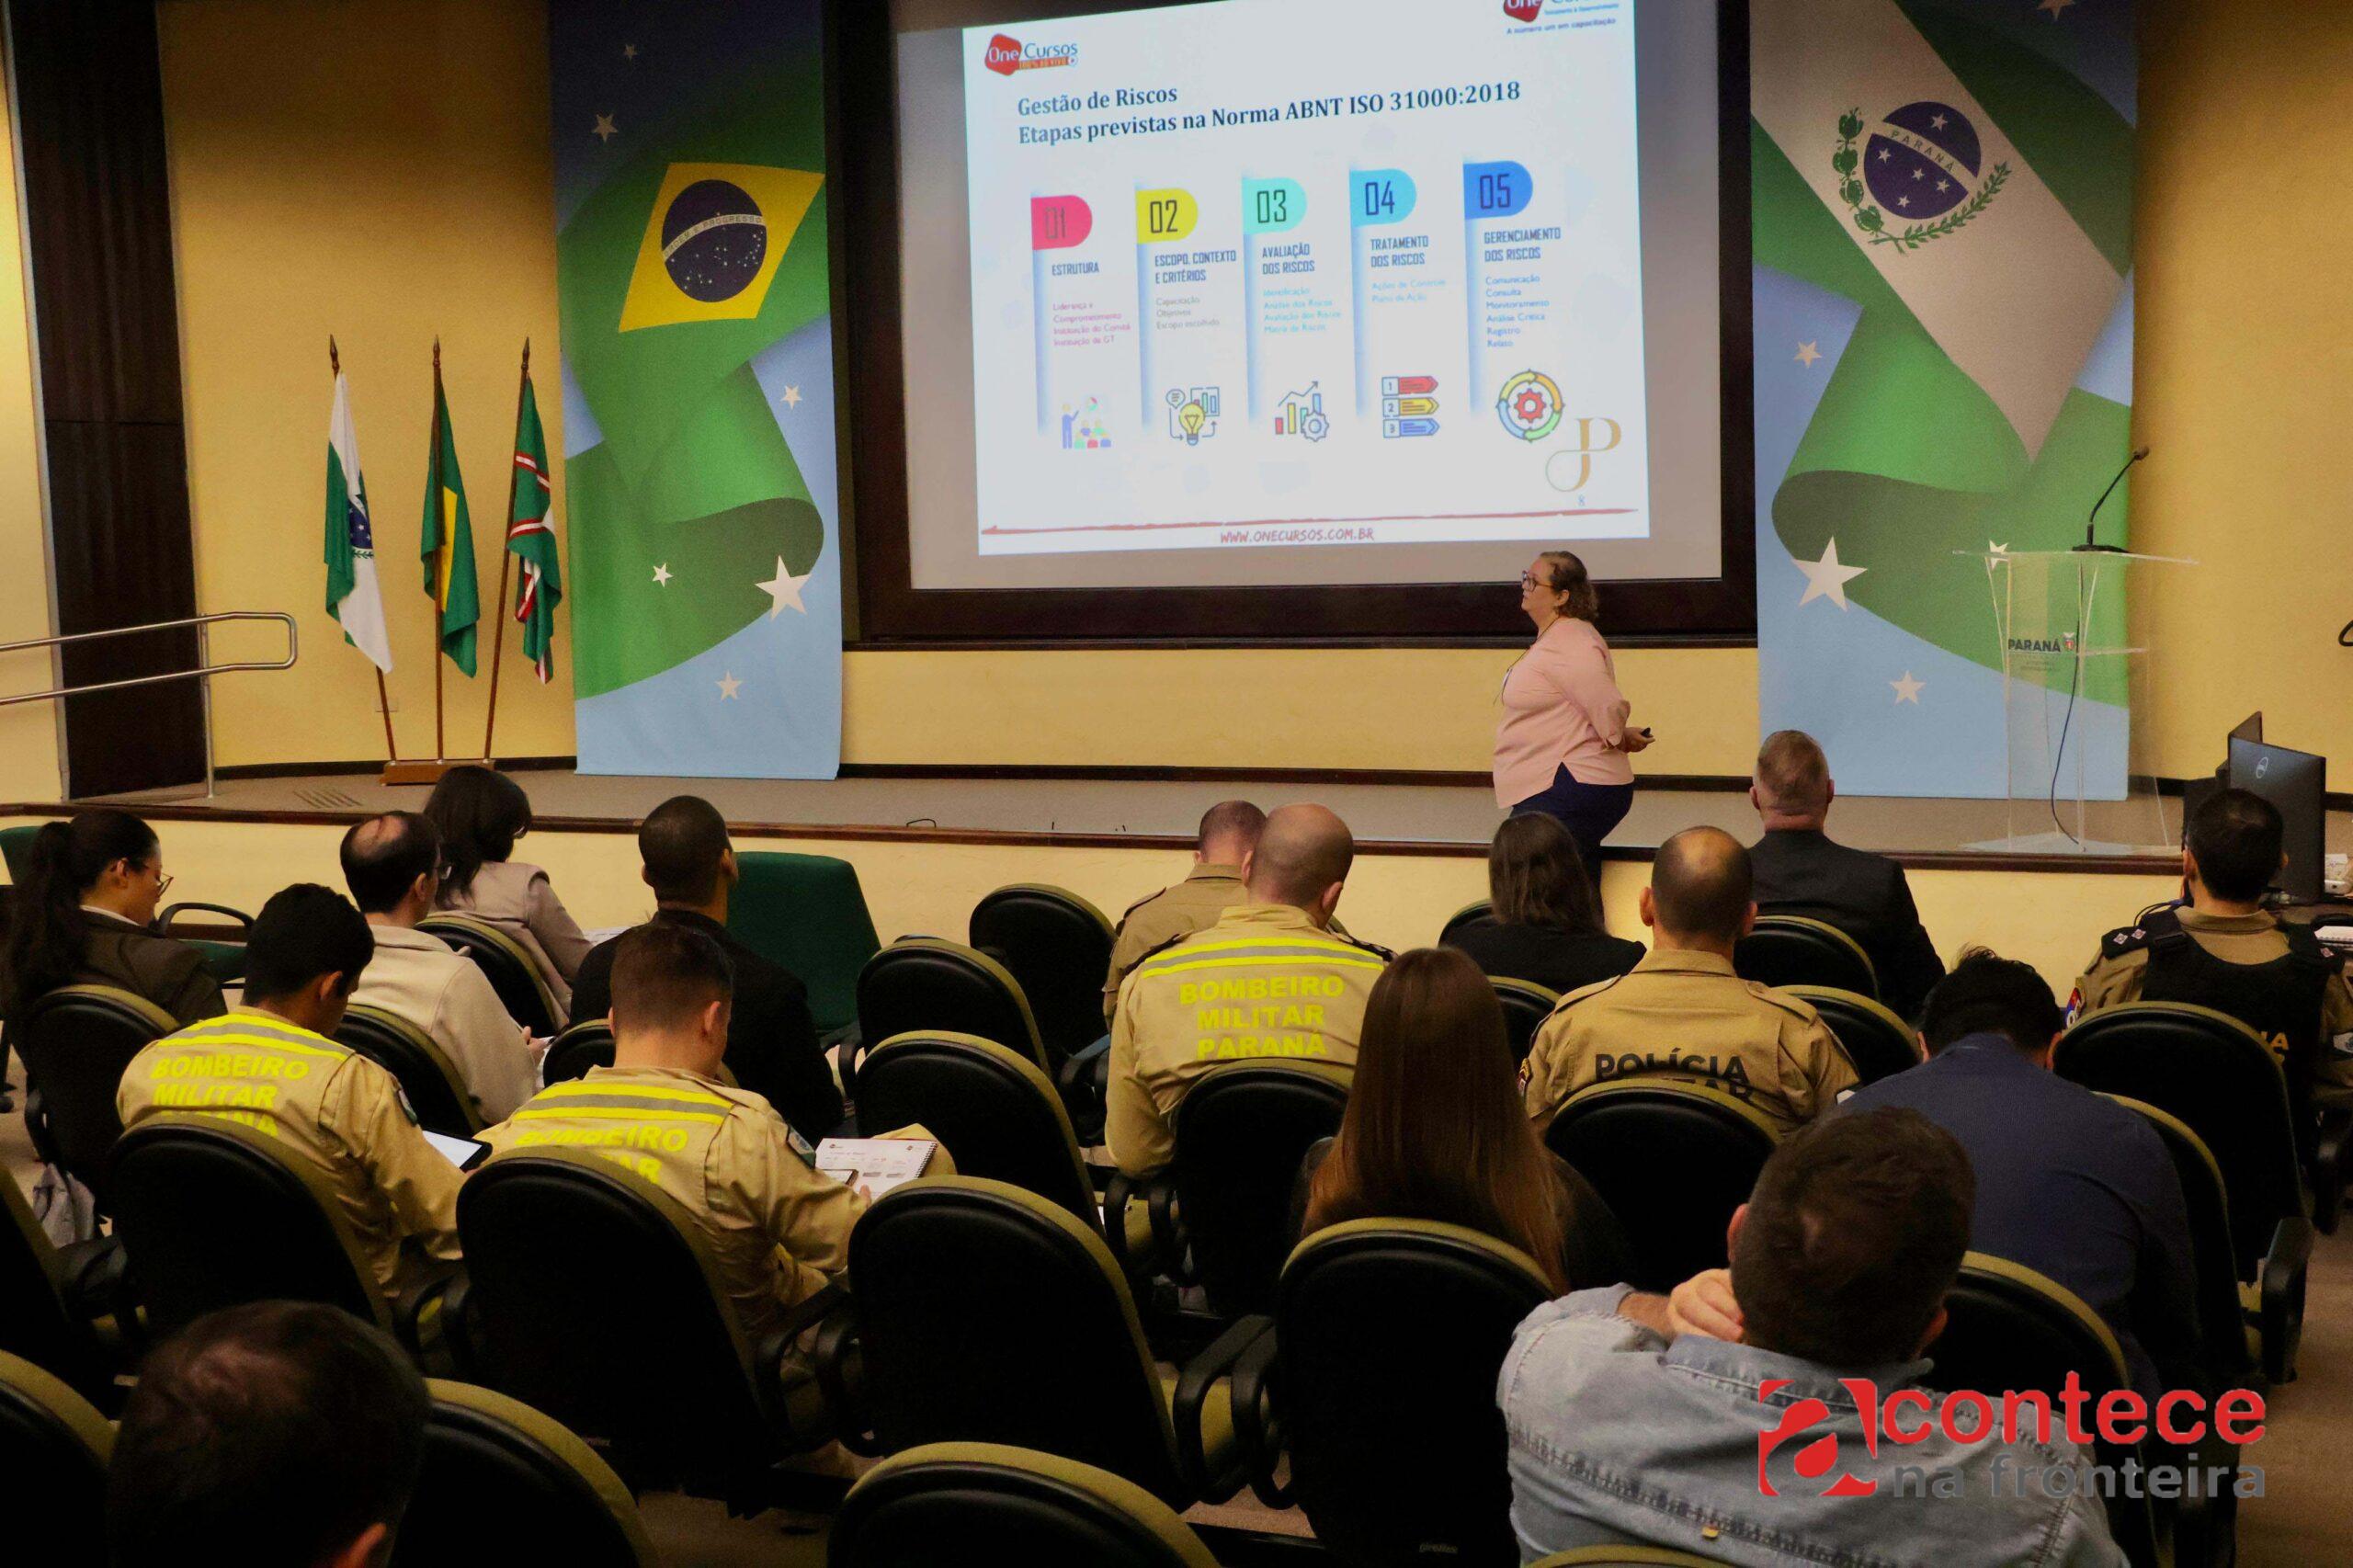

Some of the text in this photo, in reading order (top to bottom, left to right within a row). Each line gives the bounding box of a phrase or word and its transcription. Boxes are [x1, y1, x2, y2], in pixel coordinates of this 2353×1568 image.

[988, 42, 1078, 63] One Cursos
[1017, 87, 1178, 117] Gestão de Riscos
[1018, 81, 1521, 146] Etapas previstas na Norma ABNT ISO 31000:2018
[1365, 180, 1395, 216] 04
[1479, 174, 1511, 210] 05
[1256, 189, 1287, 223] 03
[703, 216, 762, 228] PROGRESSO
[1045, 205, 1066, 240] 01
[1149, 199, 1179, 234] 02
[1370, 235, 1429, 252] TRATAMENTO
[1483, 227, 1562, 244] GERENCIAMENTO
[1192, 250, 1237, 265] CONTEXTO
[1262, 243, 1310, 260] AVALIAÇÃO
[1484, 246, 1541, 262] DOS RISCOS
[1051, 261, 1100, 277] ESTRUTURA
[1262, 260, 1315, 275] DOS RISCOS
[1370, 253, 1426, 268] DOS RISCOS
[1155, 269, 1207, 284] E CRITÉRIOS
[1485, 274, 1540, 285] Comunicação
[1485, 288, 1522, 298] Consulta
[1486, 326, 1521, 337] Registro
[1220, 528, 1375, 544] WWW.ONECURSOS.COM.BR
[2007, 638, 2061, 653] PARANÁ
[1179, 974, 1346, 1005] BOMBEIRO
[1197, 1004, 1325, 1030] MILITAR
[151, 1055, 310, 1080] BOMBEIRO
[153, 1083, 278, 1109] MILITAR
